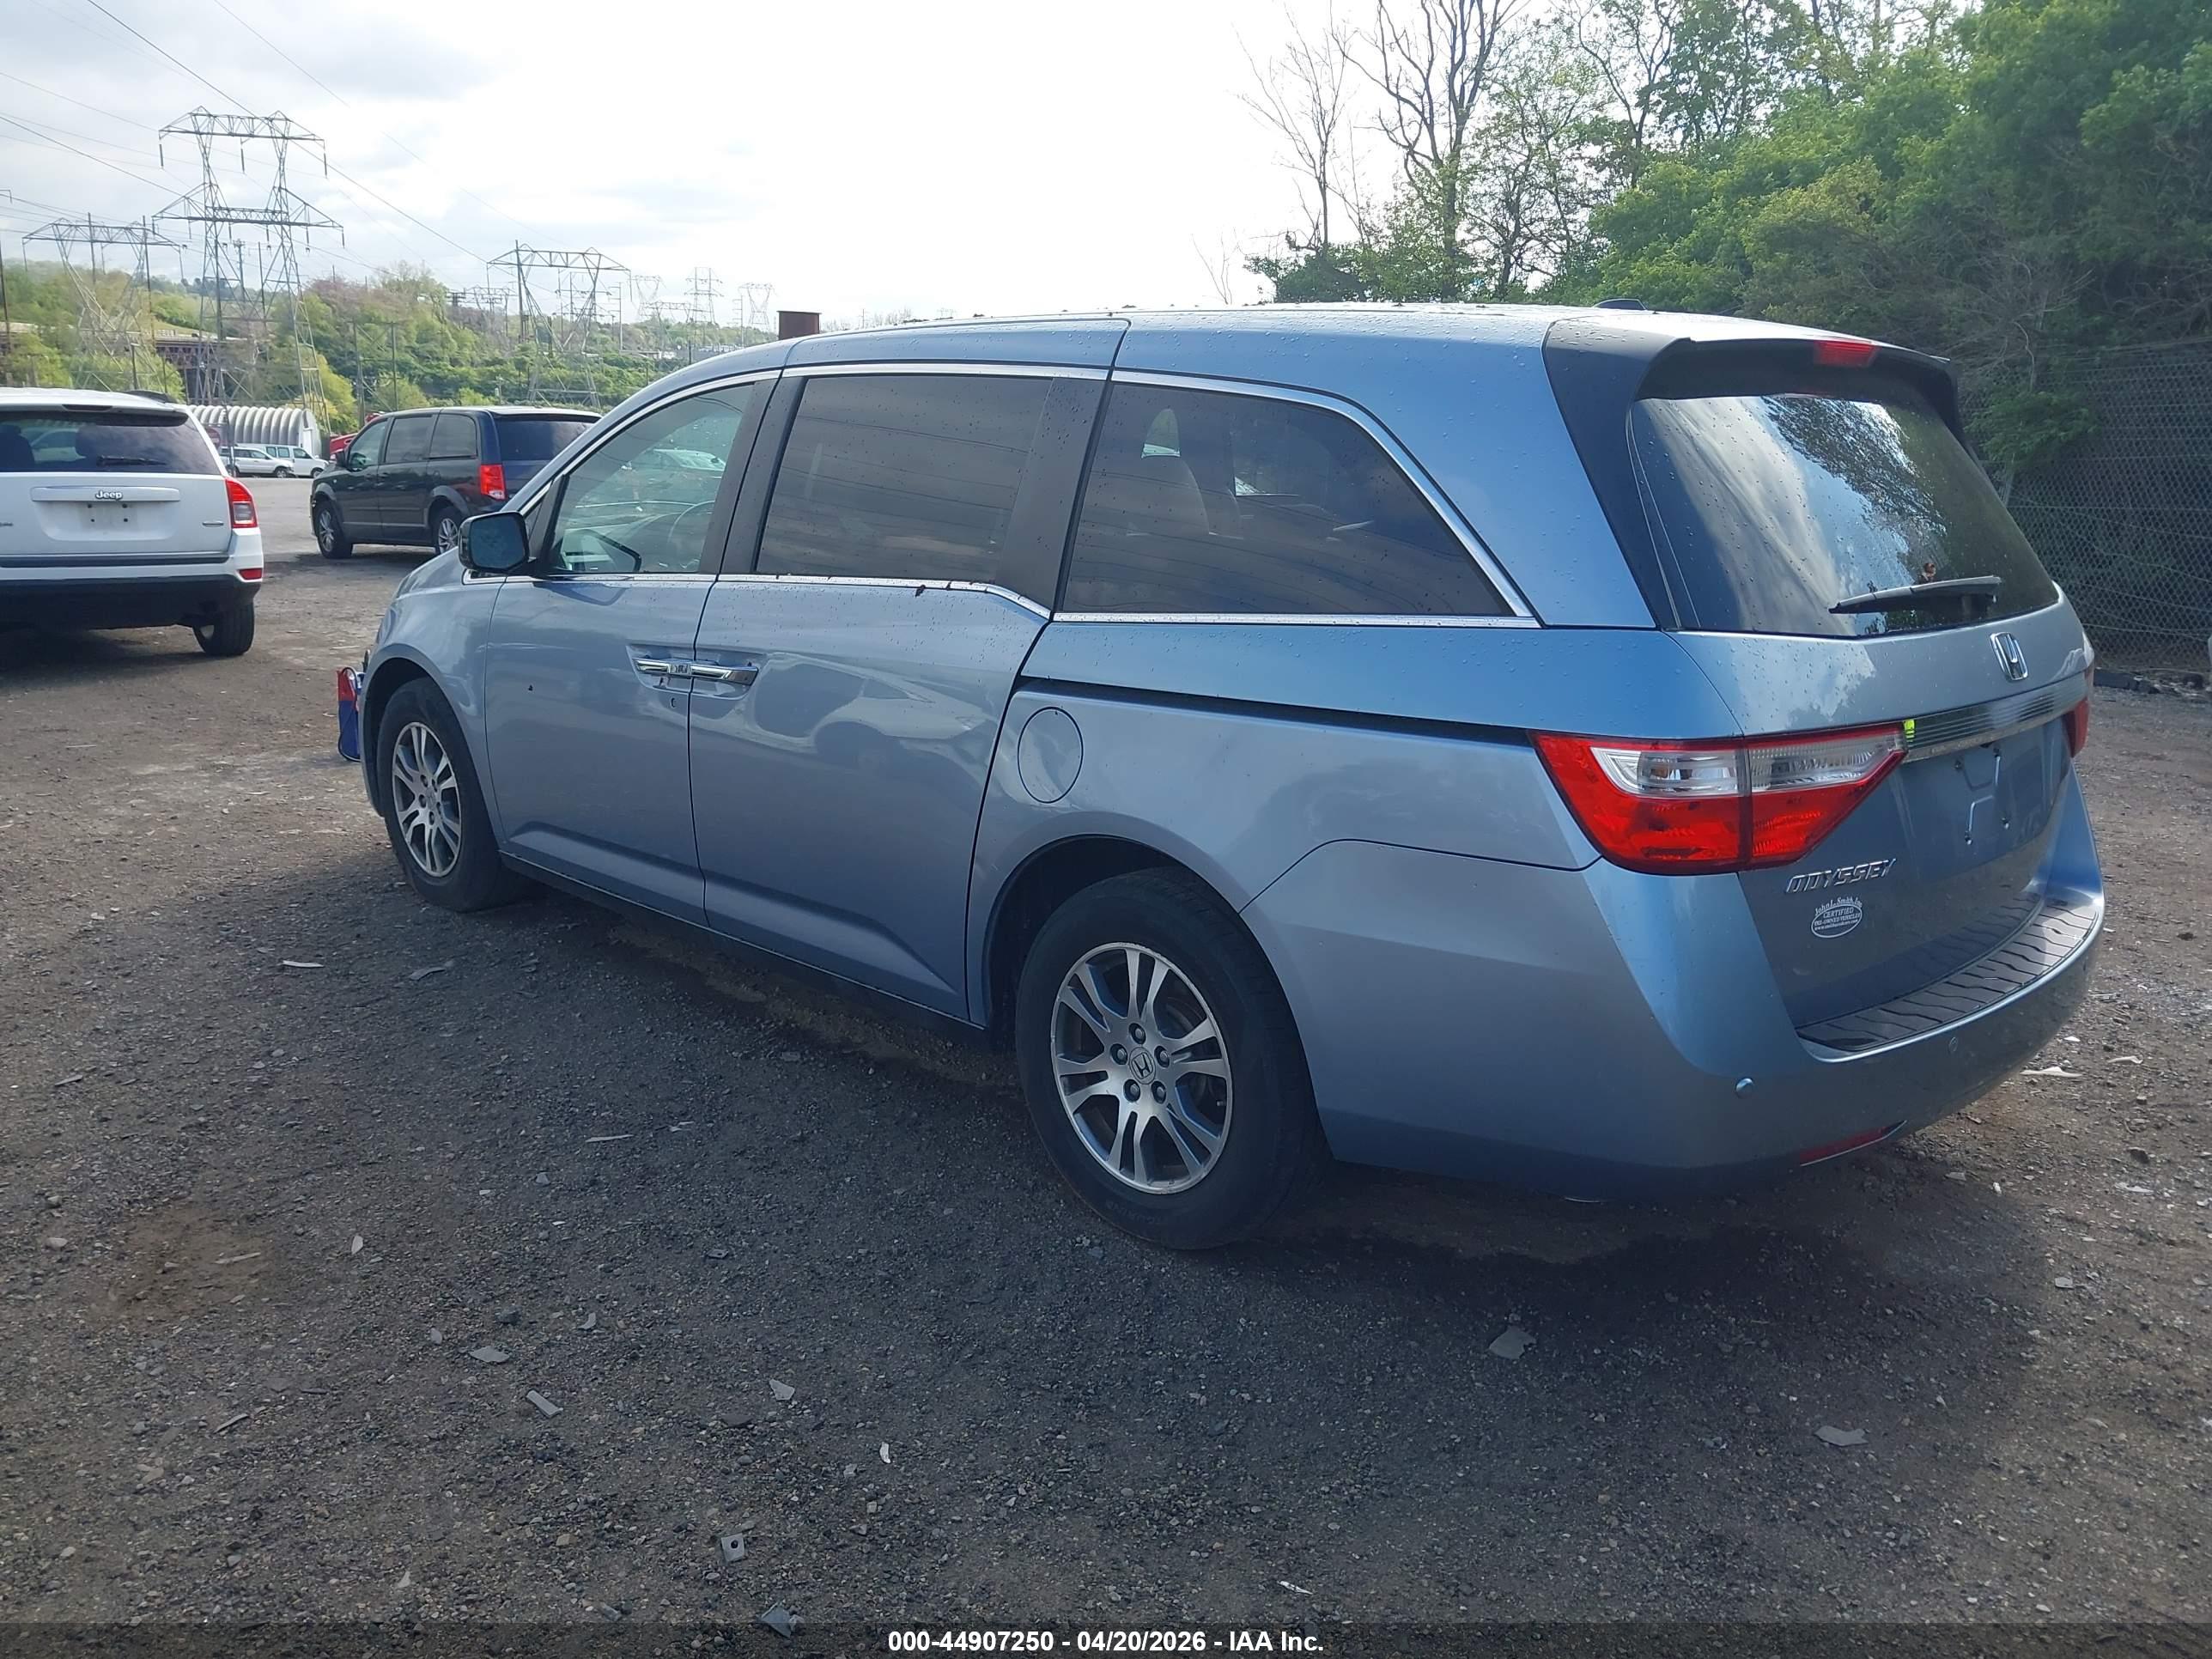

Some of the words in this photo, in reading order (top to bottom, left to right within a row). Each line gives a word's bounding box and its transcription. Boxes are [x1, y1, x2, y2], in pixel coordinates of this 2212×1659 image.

[95, 489, 123, 500] Jeep
[1786, 859, 1896, 892] ODYSSEY
[1823, 907, 1854, 918] CERTIFIED
